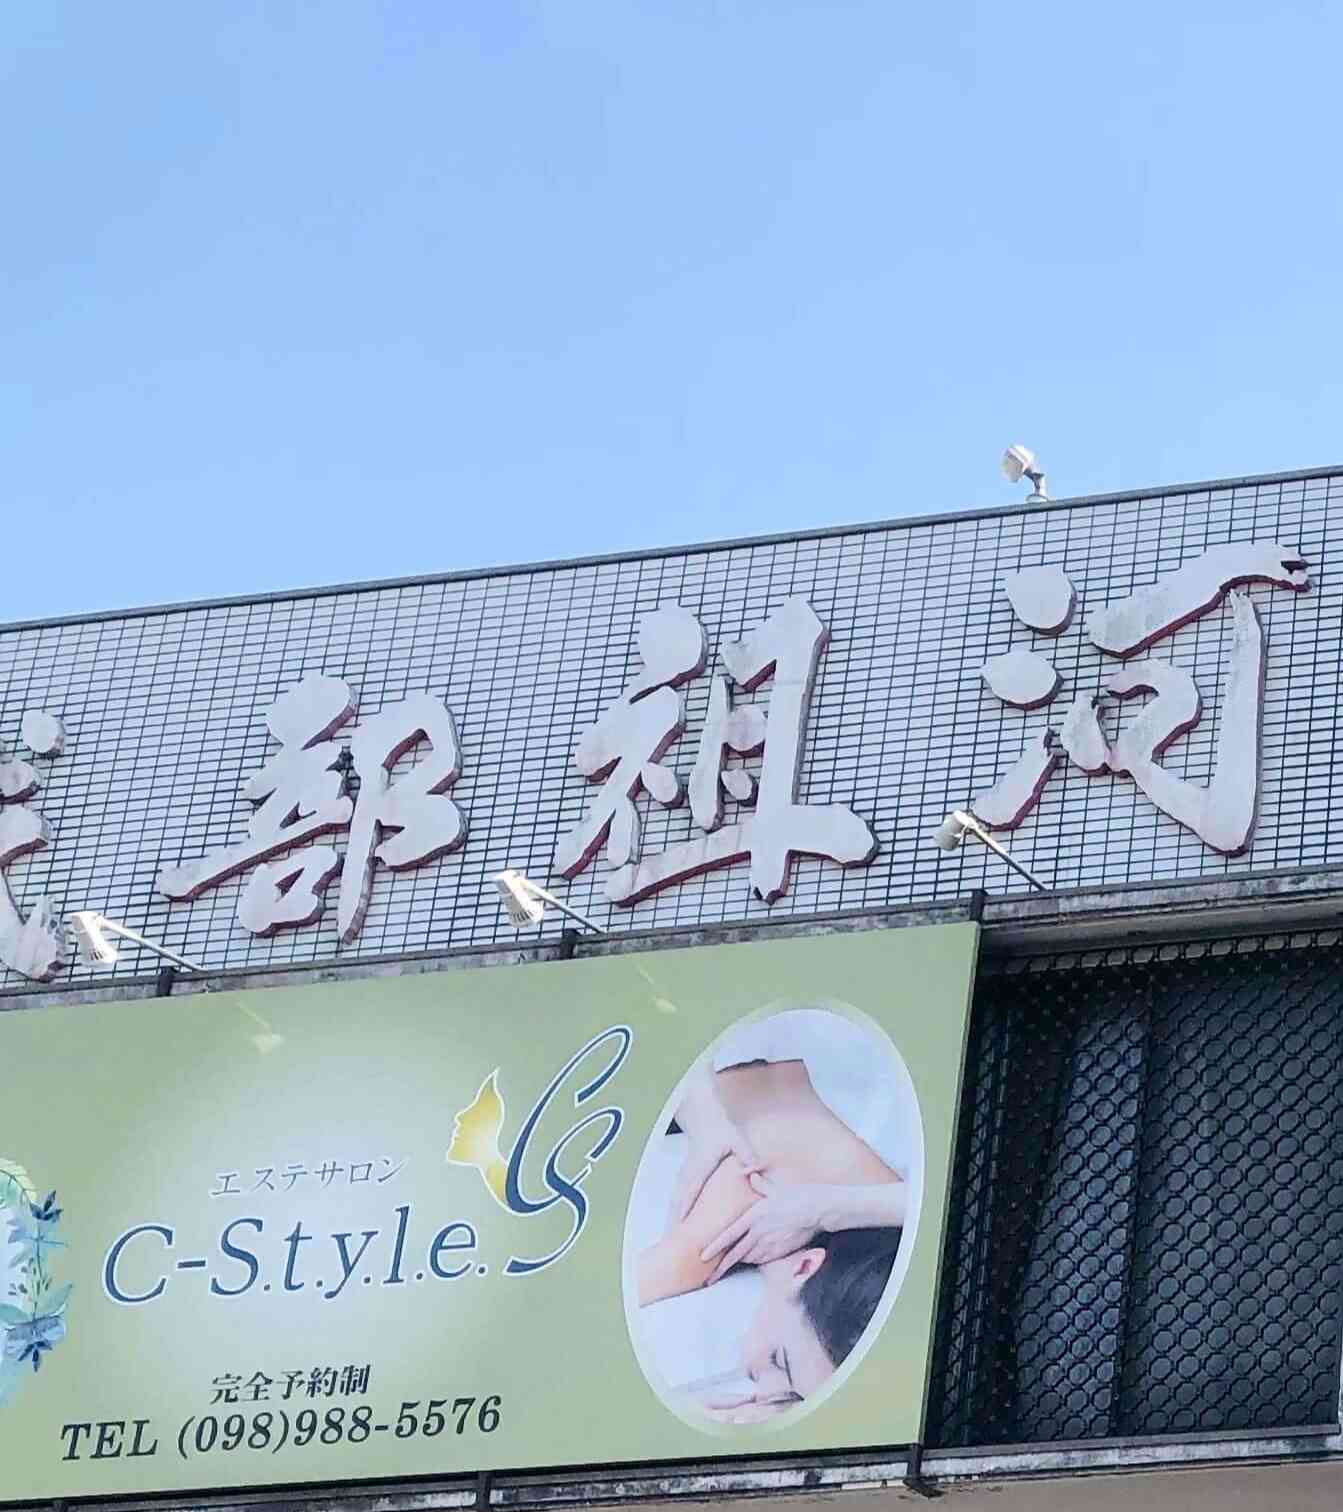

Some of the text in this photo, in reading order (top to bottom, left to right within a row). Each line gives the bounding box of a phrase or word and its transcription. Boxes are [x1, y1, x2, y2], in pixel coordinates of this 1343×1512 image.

[211, 1154, 408, 1198] エステサロン
[211, 1364, 371, 1404] 完全予約制
[60, 1394, 502, 1461] TEL (098)988-5576
